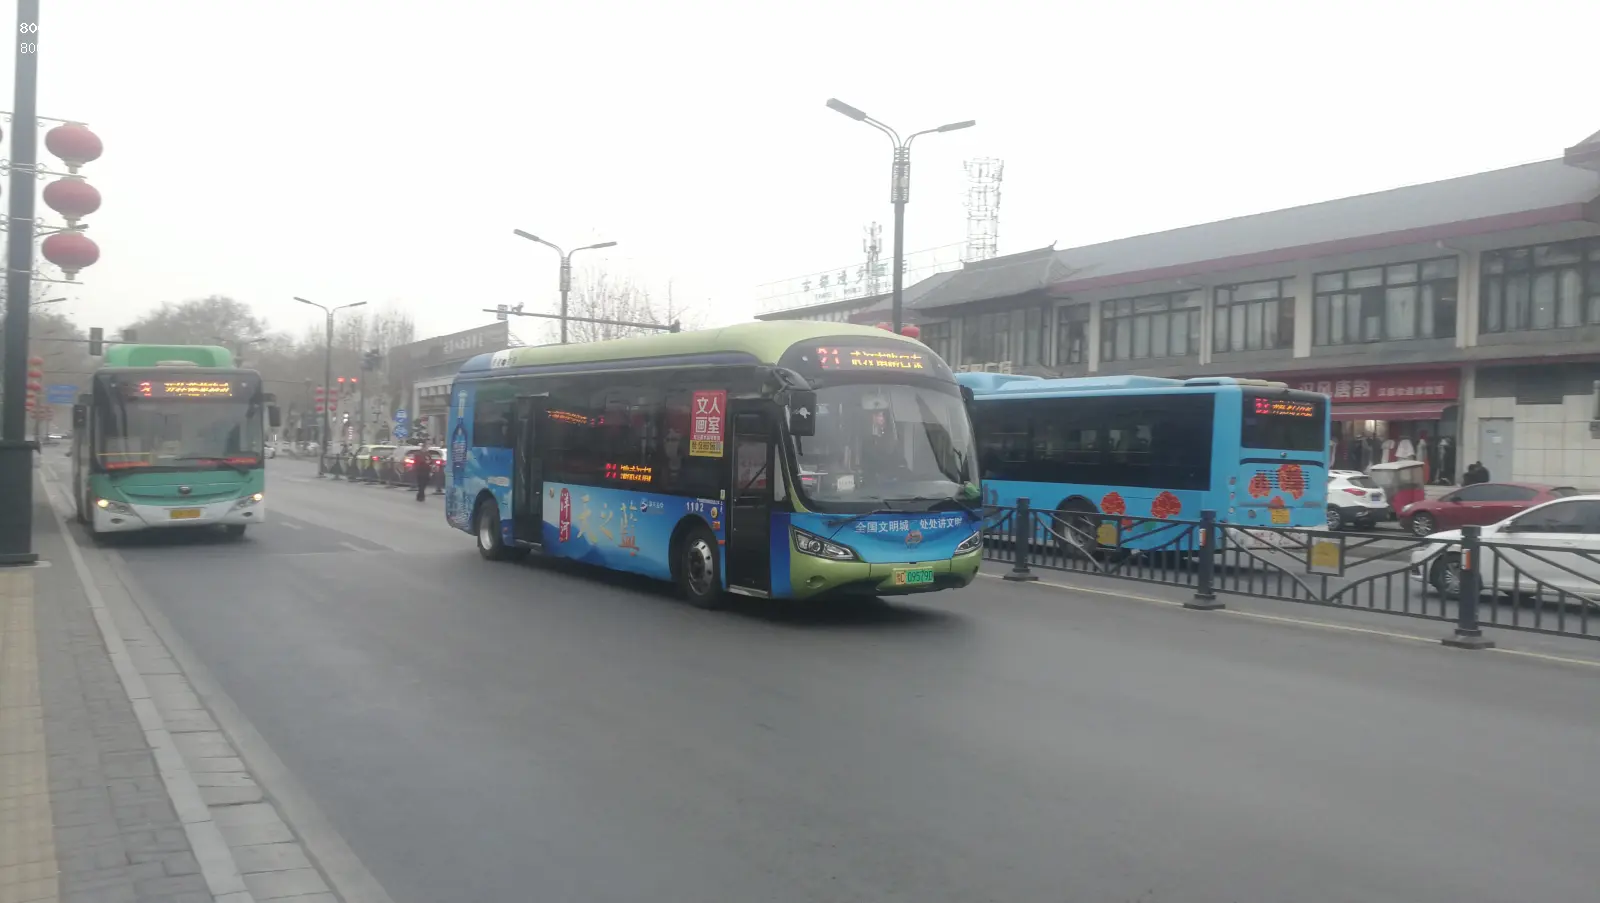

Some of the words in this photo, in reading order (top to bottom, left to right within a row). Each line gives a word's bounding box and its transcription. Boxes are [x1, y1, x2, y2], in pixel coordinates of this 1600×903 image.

[696, 397, 721, 415] 文人
[695, 415, 721, 434] 画室
[686, 501, 704, 513] 1102
[855, 520, 909, 534] 全国文明城
